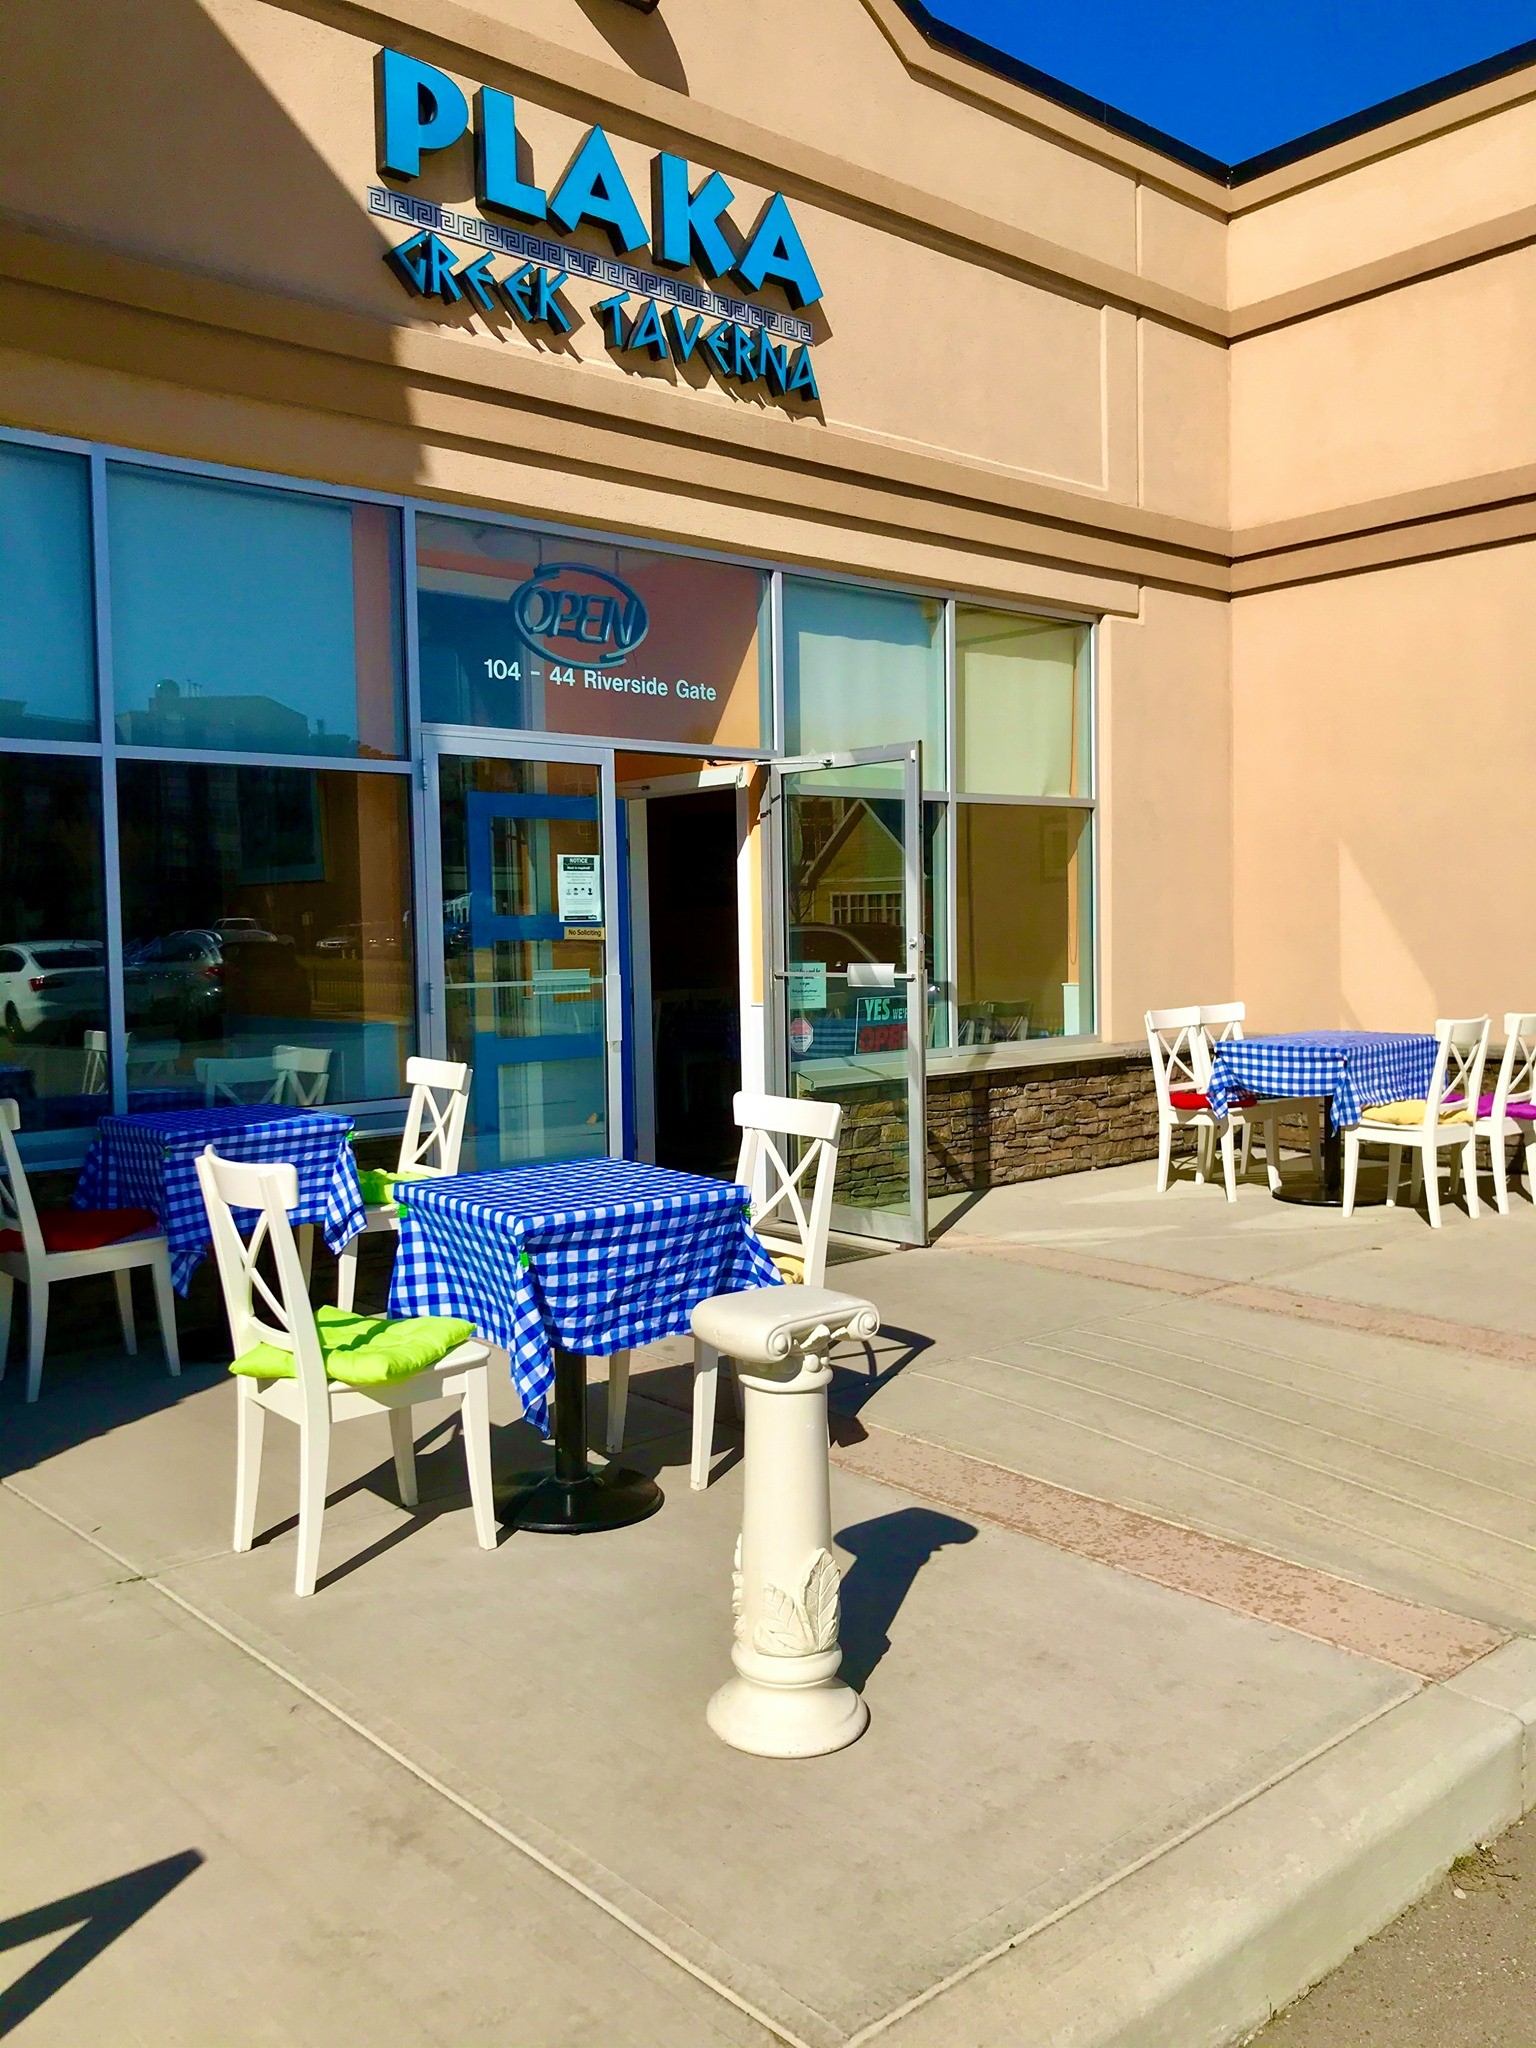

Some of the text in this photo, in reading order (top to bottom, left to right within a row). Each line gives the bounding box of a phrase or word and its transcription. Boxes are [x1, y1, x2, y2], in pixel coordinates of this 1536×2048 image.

[374, 47, 823, 308] PLAKA
[384, 230, 820, 400] GREEK TAVERNA
[522, 585, 638, 647] OPEN
[483, 658, 522, 681] 104
[549, 667, 576, 687] 44
[584, 669, 669, 697] Riverside
[675, 680, 717, 702] Gate
[577, 929, 602, 938] Soliciting
[865, 998, 890, 1021] YES
